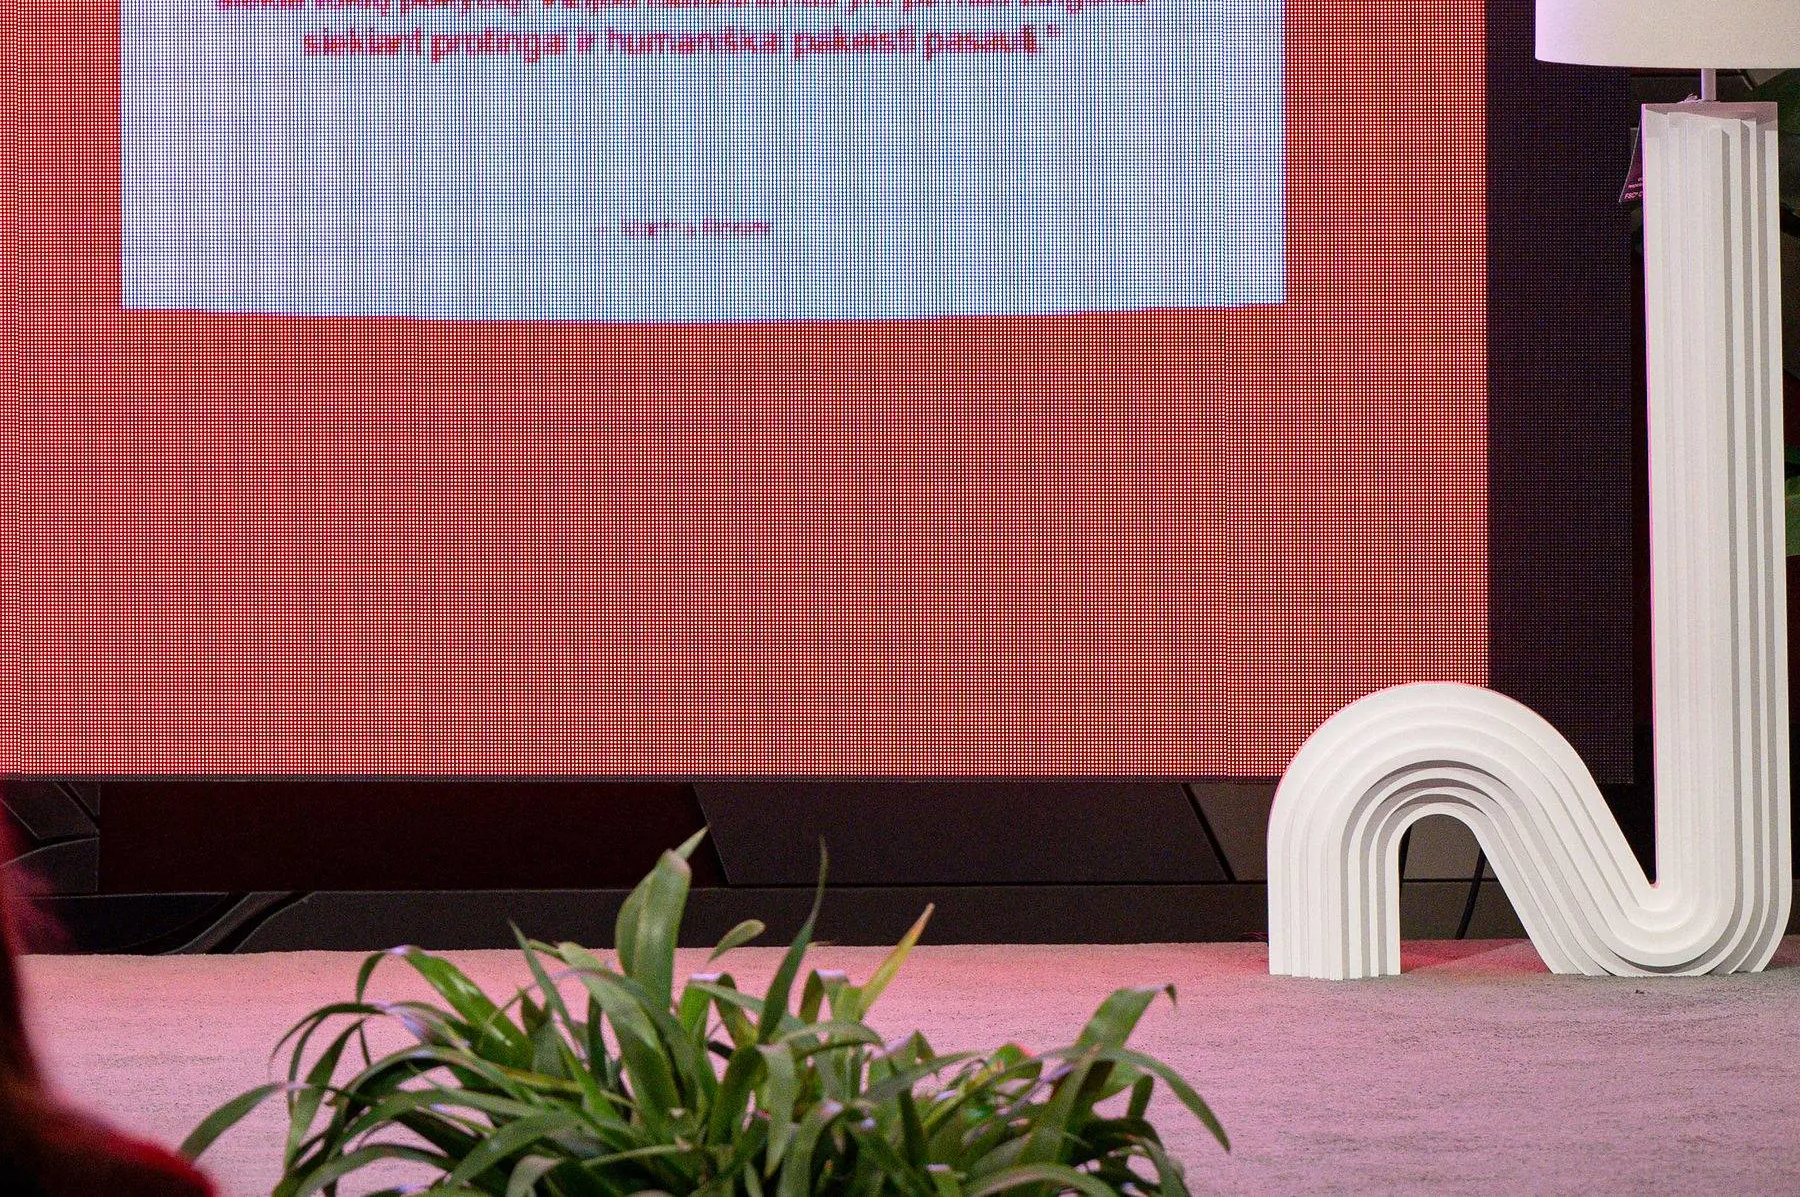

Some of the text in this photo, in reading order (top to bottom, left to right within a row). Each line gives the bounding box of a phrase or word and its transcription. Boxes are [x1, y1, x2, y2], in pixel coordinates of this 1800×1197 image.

[302, 27, 423, 55] siekiant
[430, 27, 567, 64] protingai
[576, 31, 597, 55] ir
[607, 26, 782, 55] humaniškai
[792, 27, 915, 60] pakeisti
